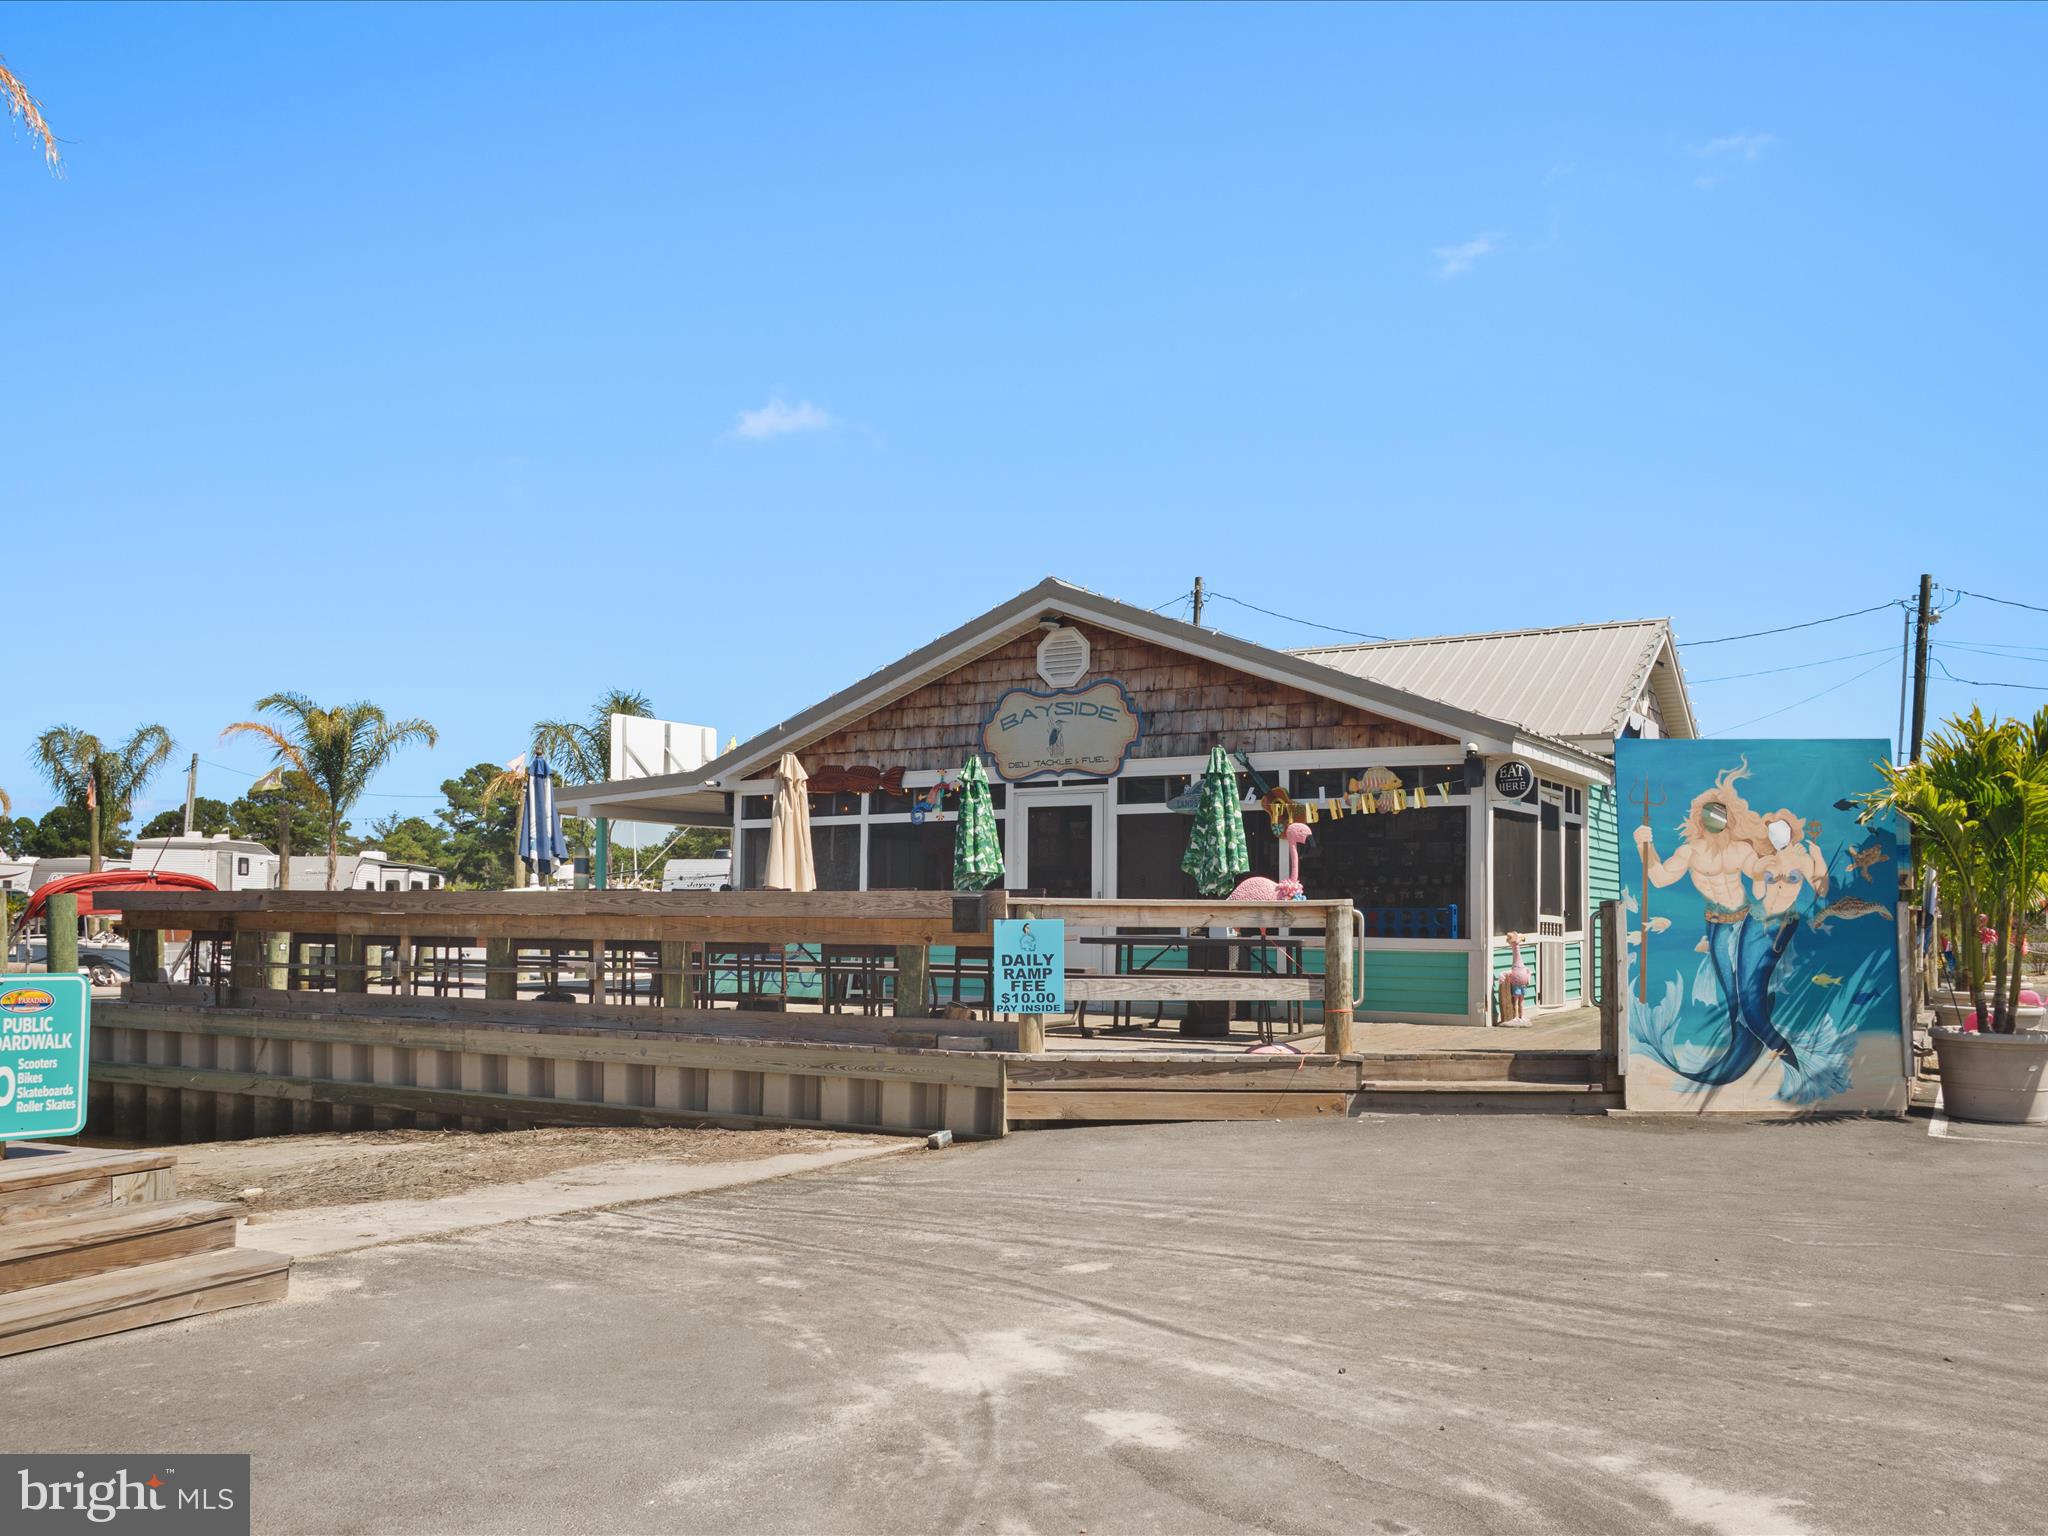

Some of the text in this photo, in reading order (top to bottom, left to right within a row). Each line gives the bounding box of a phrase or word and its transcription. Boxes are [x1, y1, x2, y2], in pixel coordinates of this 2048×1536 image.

[1000, 702, 1120, 731] BAYSIDE
[1034, 758, 1072, 767] TACKLE
[1082, 756, 1109, 764] FUEL
[1500, 764, 1525, 778] EAT
[1500, 781, 1526, 791] HERE
[1001, 953, 1055, 966] DAILY
[1003, 968, 1053, 979] RAMP
[1011, 980, 1045, 992] FEE
[18, 996, 49, 1004] PARADISE
[1001, 992, 1056, 1004] $10.00
[996, 1004, 1061, 1012] PAY INSIDE
[3, 1016, 54, 1034] PUBLIC
[0, 1033, 72, 1051] ARDWALK
[18, 1058, 58, 1070] Scooters
[17, 1072, 43, 1084] Bikes
[16, 1084, 74, 1099] Skateboards
[16, 1099, 76, 1113] Roller Skates
